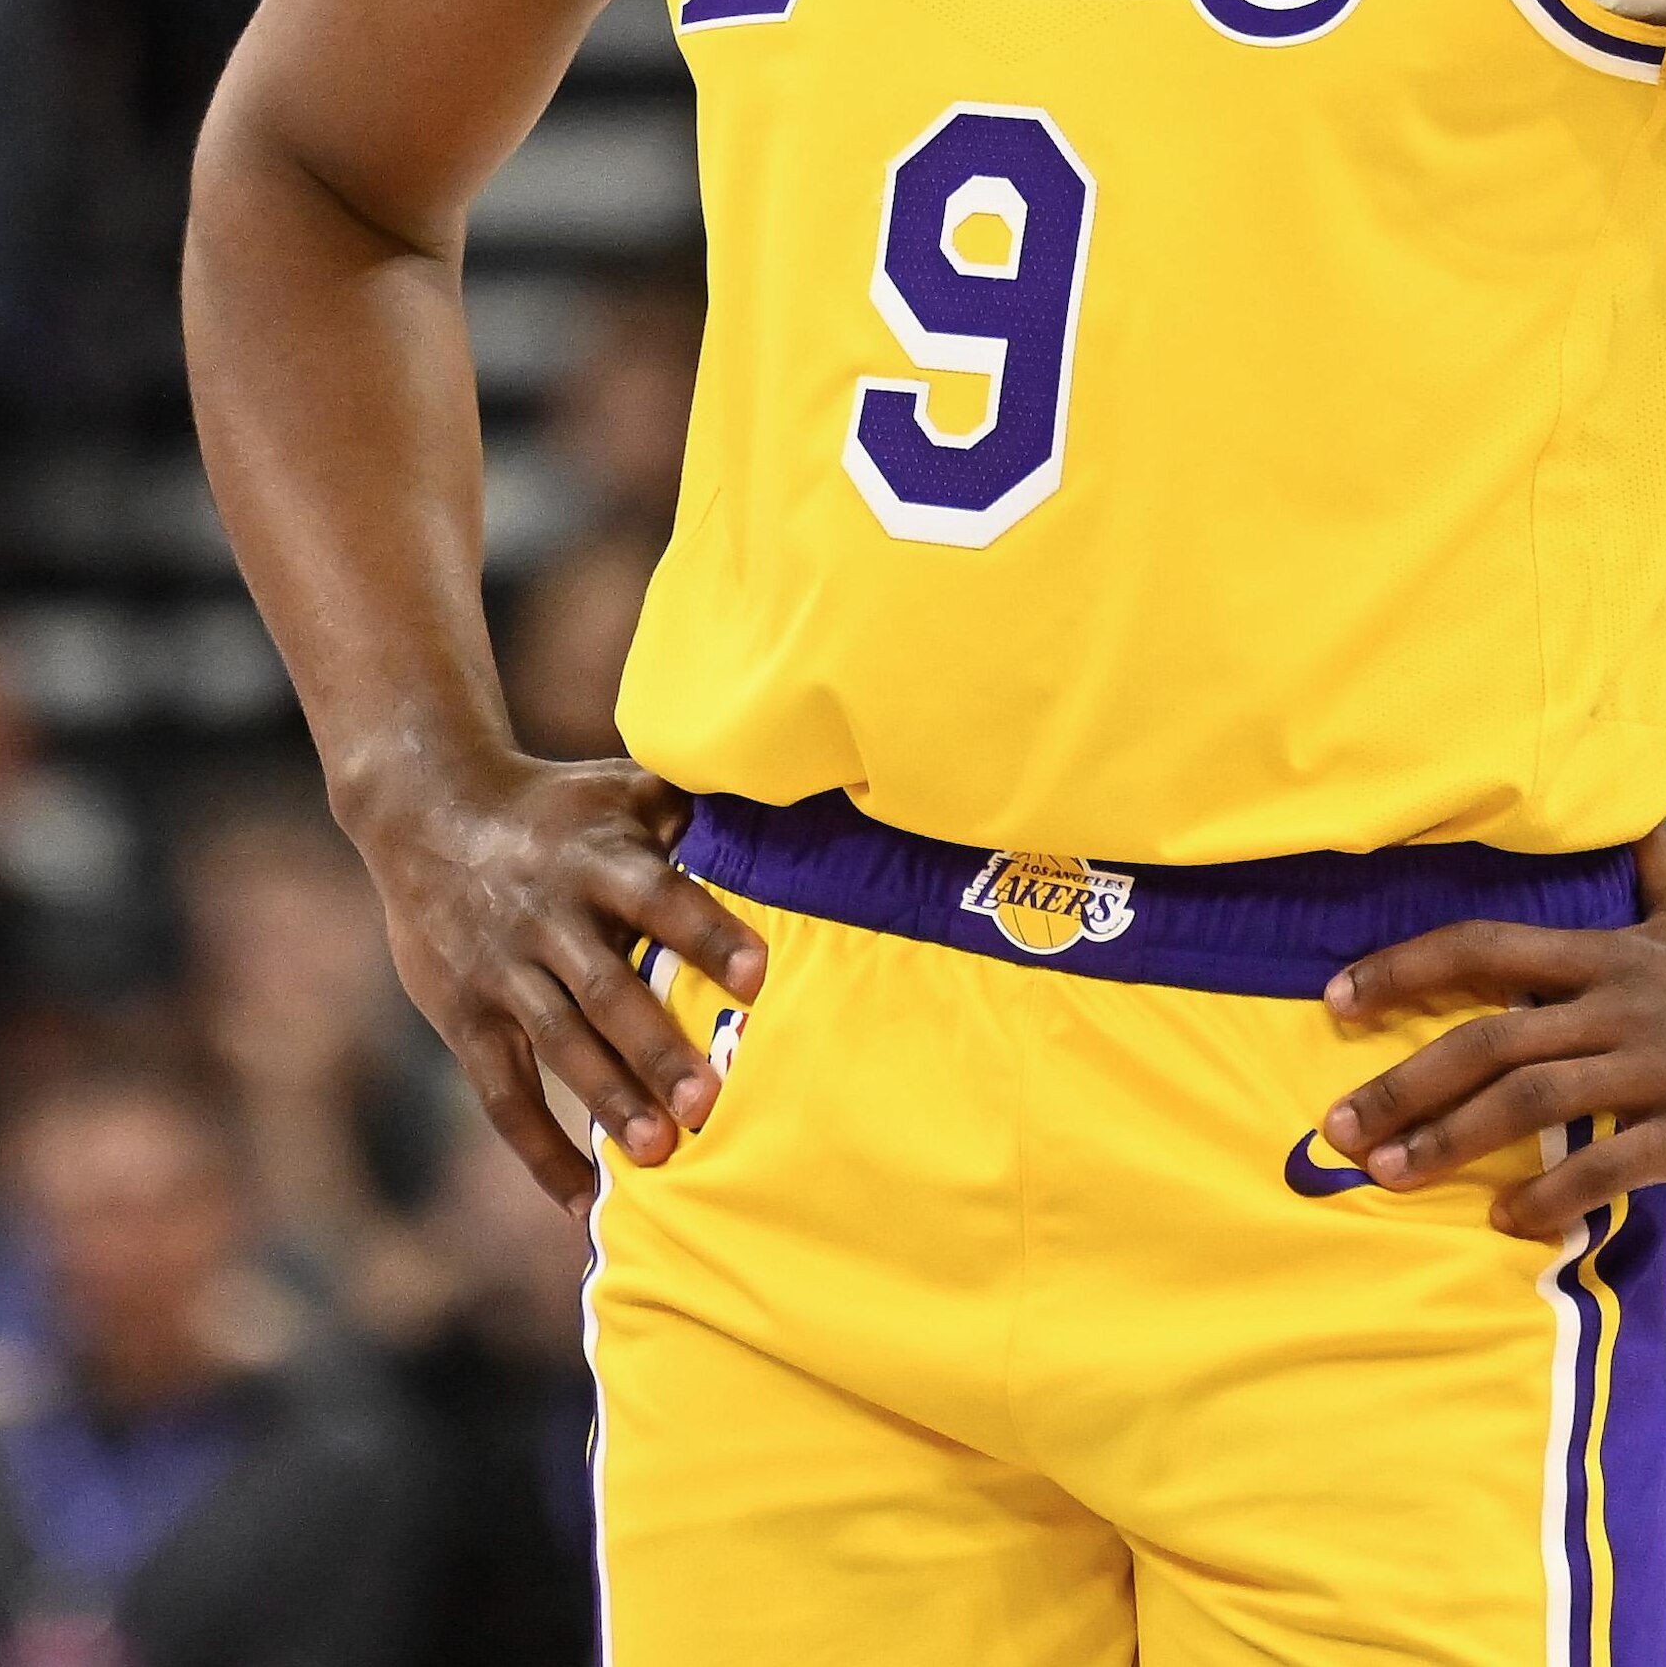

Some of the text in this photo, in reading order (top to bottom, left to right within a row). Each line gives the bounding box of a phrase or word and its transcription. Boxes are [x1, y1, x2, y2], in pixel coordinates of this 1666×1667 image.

[843, 102, 1096, 548] 9
[969, 856, 1125, 934] LAKERS
[1021, 862, 1127, 890] LOS ANGELES
